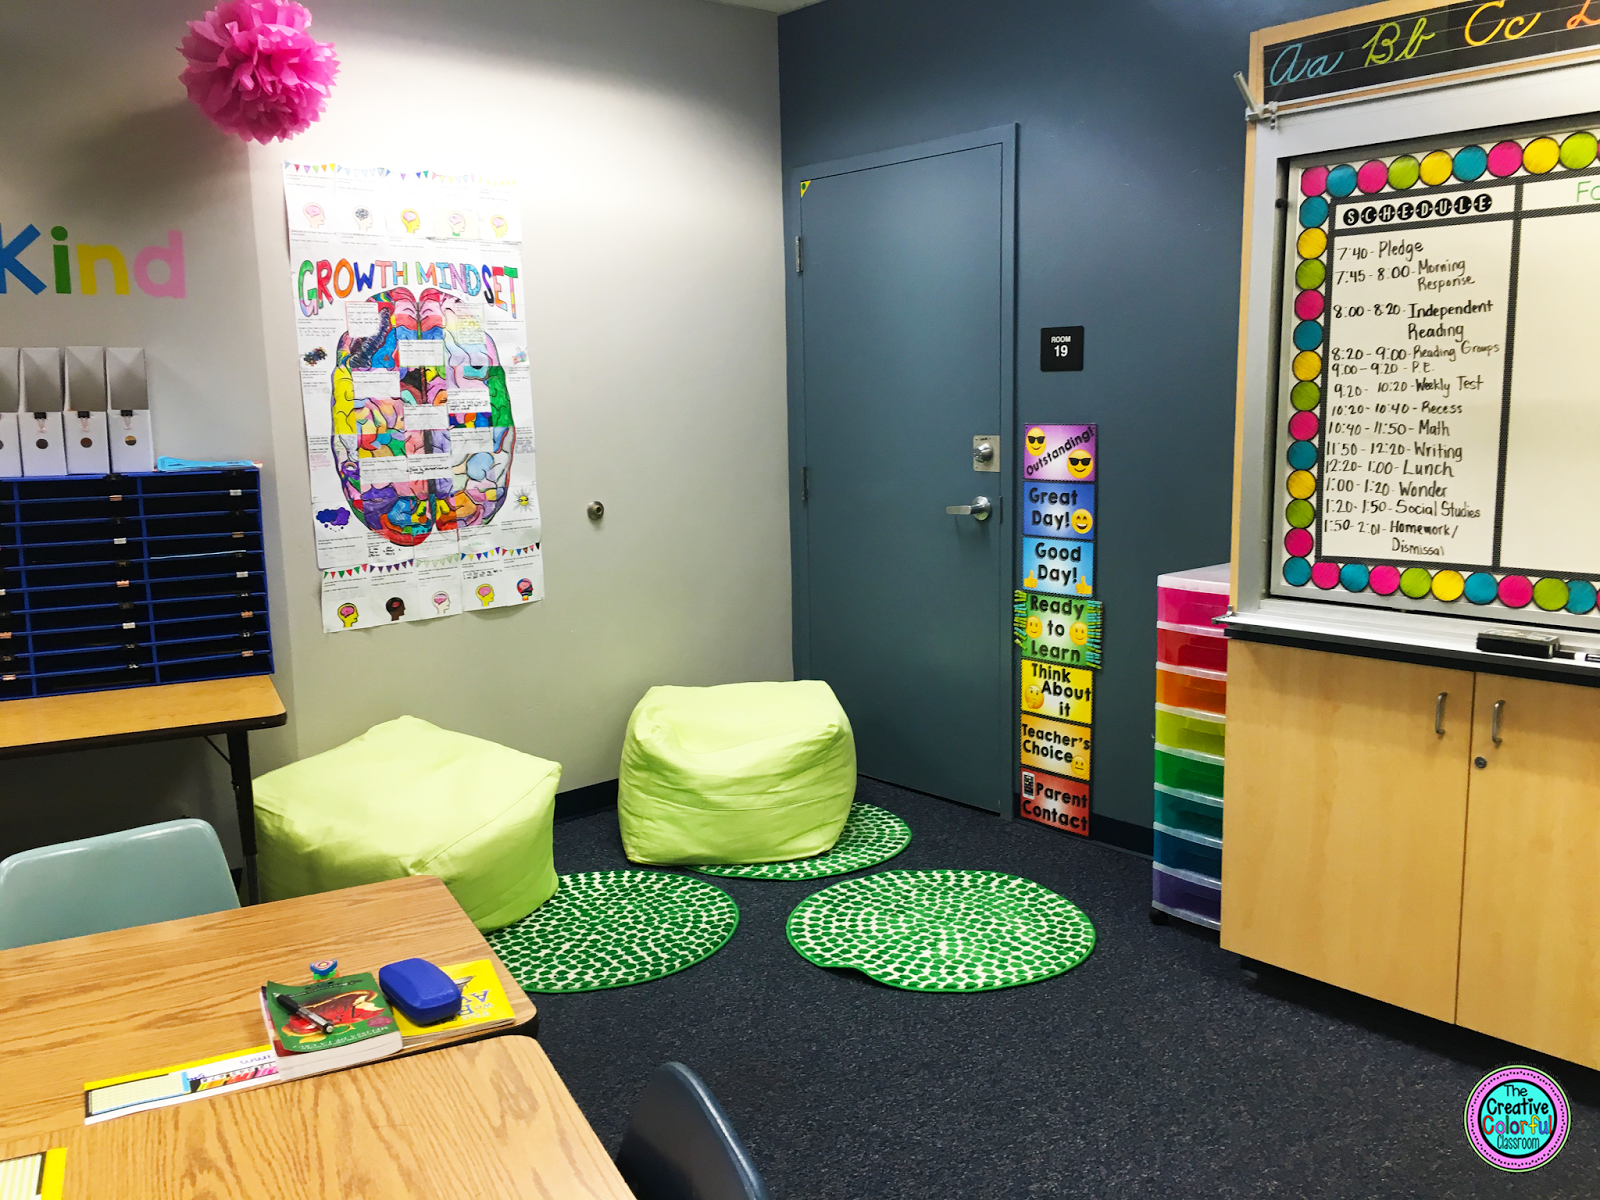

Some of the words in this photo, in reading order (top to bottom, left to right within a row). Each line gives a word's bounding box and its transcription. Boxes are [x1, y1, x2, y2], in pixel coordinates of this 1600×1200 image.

[1269, 43, 1344, 87] Aa
[1361, 17, 1436, 67] Bb
[1464, 1, 1542, 47] Cc
[1343, 193, 1493, 226] SCHEDULE
[1378, 238, 1424, 262] Pledge
[1418, 258, 1466, 276] Morning
[298, 258, 408, 317] GROWTH
[415, 261, 518, 319] MINDSET
[1417, 274, 1475, 293] Response
[1407, 299, 1494, 320] Independent
[1051, 335, 1071, 343] ROOM
[1407, 322, 1465, 343] Reading
[1054, 345, 1068, 357] 19
[1413, 344, 1456, 362] Reading
[1460, 340, 1500, 355] Groups
[1415, 377, 1450, 398] Weekly
[1457, 375, 1484, 391] Test
[1421, 401, 1463, 415] Recess
[1418, 419, 1450, 436] Math
[1026, 426, 1095, 476] Outstanding!
[1414, 441, 1463, 462] Writing
[1402, 459, 1455, 477] Lunch
[1028, 487, 1078, 506] Great
[1399, 480, 1448, 497] Wonder
[1395, 499, 1438, 517] Social
[1440, 500, 1481, 518] Studies
[1031, 510, 1070, 531] Day!
[1035, 542, 1082, 562] Good
[1391, 536, 1445, 556] Dismissal
[1037, 564, 1077, 586] Day!
[1030, 594, 1085, 620] Ready
[1047, 620, 1065, 637] to
[1031, 640, 1081, 662] Learn
[1031, 663, 1071, 683] Think
[1041, 680, 1091, 702] About
[1059, 702, 1071, 717] it
[1021, 723, 1091, 750] Teacher's
[1022, 740, 1073, 763] Choice
[1036, 783, 1088, 808] Parent
[1022, 800, 1088, 831] Contact
